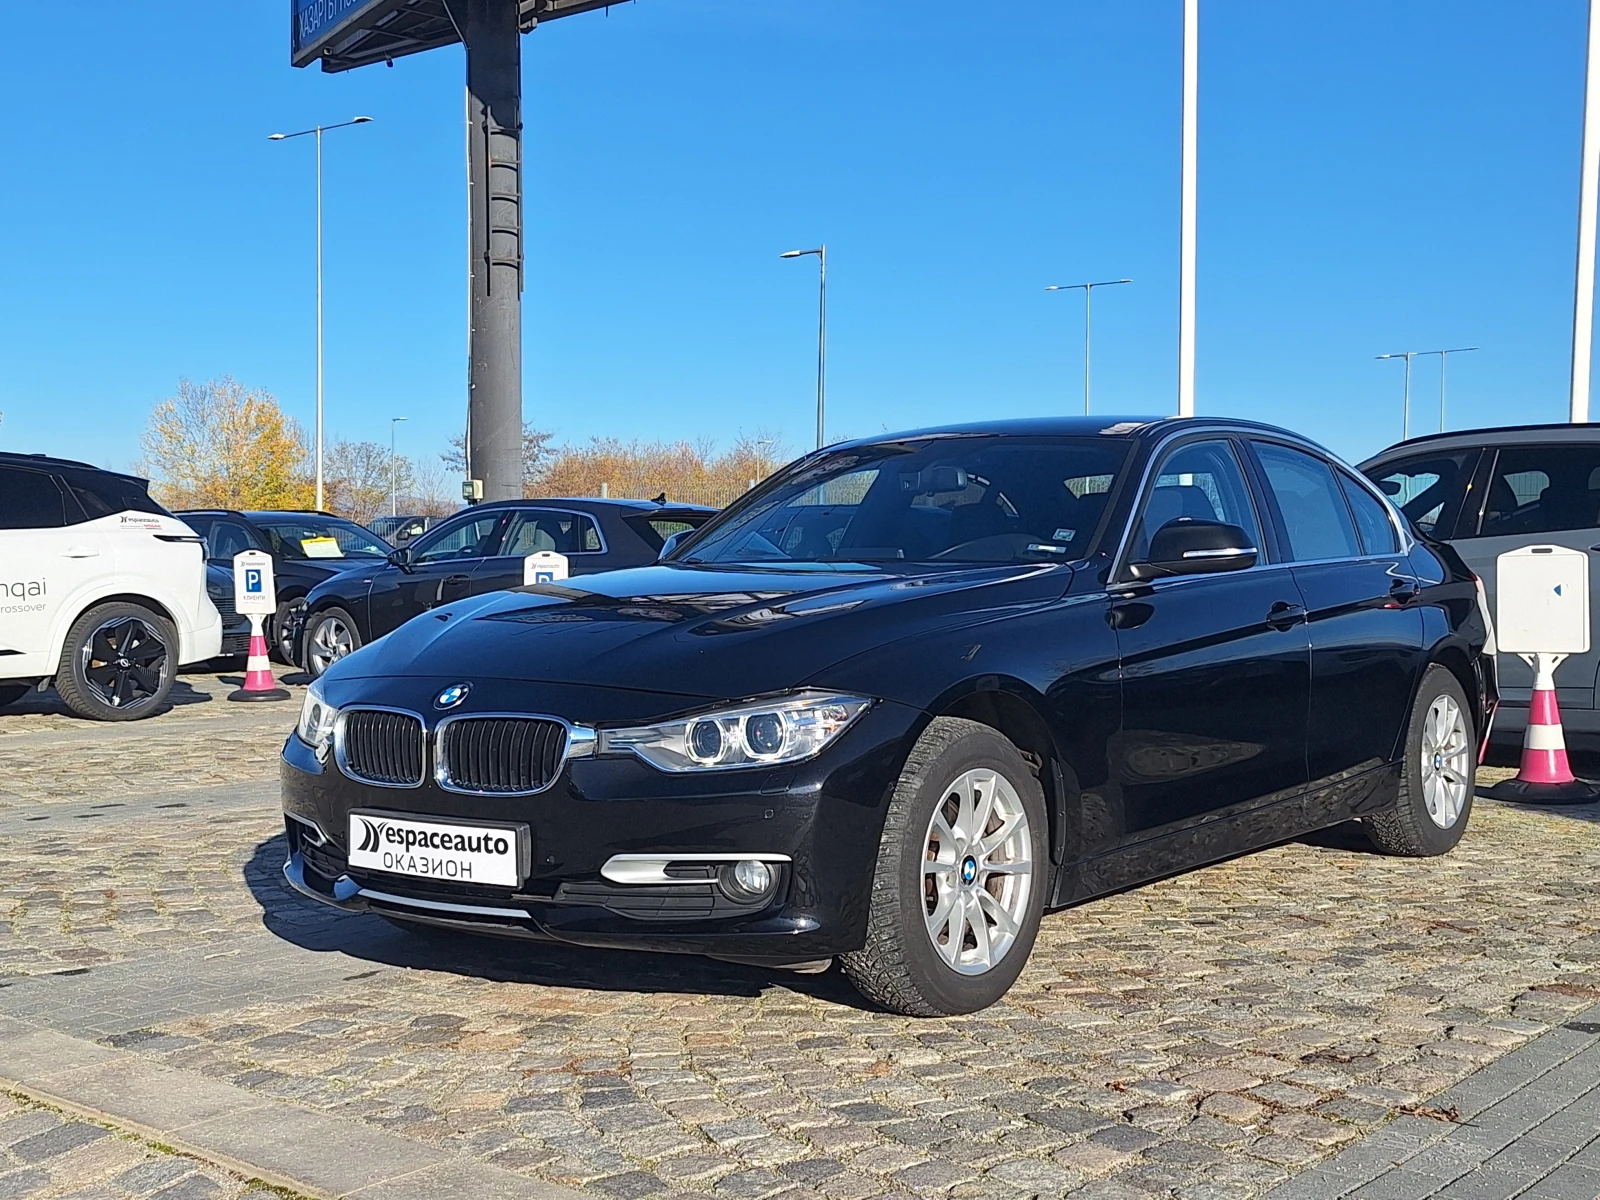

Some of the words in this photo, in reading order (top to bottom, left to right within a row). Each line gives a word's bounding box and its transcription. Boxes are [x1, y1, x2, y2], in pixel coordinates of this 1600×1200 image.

[248, 571, 259, 590] P
[385, 826, 509, 855] espaceauto
[383, 852, 472, 879] ОКАЗИОН
